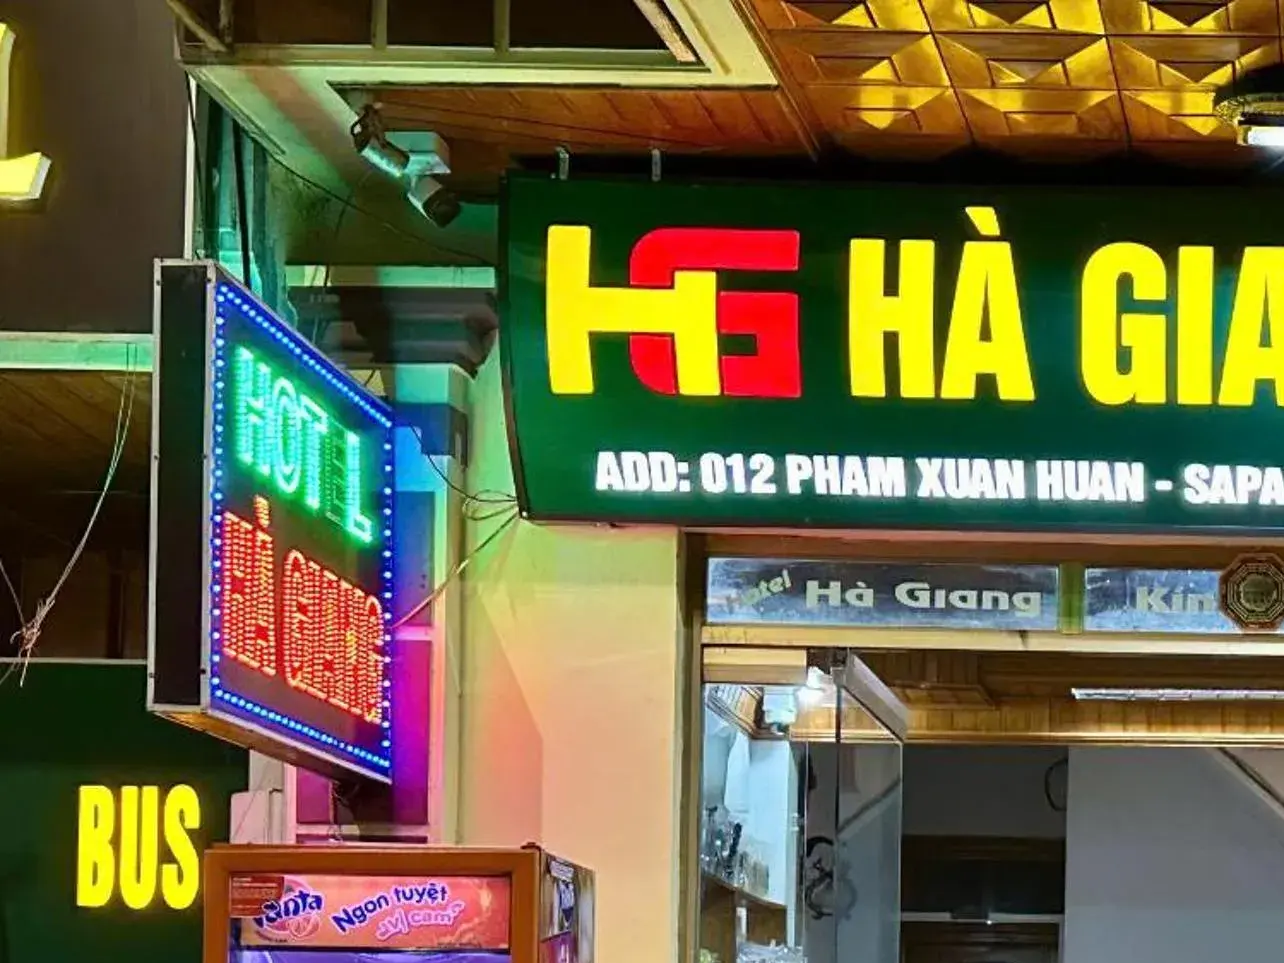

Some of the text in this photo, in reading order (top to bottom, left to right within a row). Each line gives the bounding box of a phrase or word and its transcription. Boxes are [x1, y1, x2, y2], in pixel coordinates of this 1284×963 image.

[848, 206, 1035, 400] HÀ
[596, 452, 690, 493] ADD:
[700, 455, 776, 494] 012
[786, 456, 906, 498] PHAM
[916, 459, 1026, 500] XUAN
[1036, 462, 1145, 502] HUAN
[895, 581, 1042, 618] Giang
[76, 784, 200, 910] BUS
[332, 883, 447, 931] Ngon tuyệt
